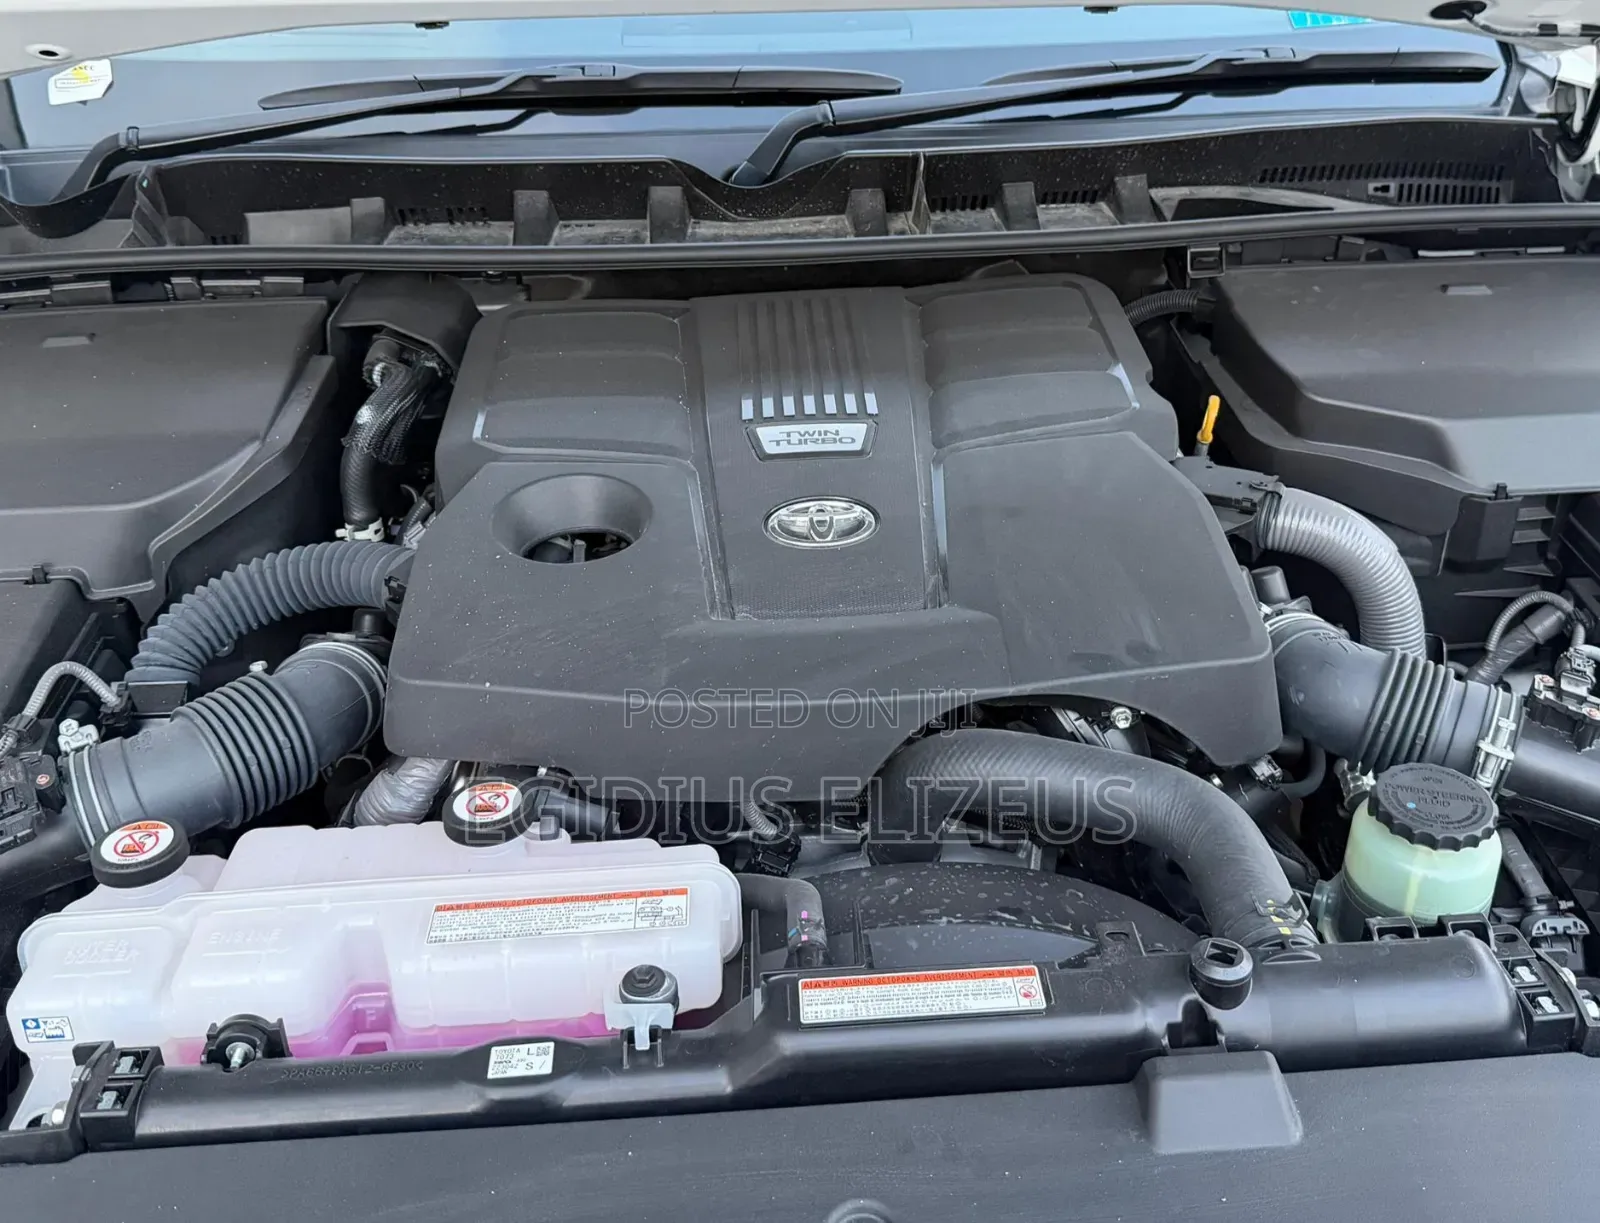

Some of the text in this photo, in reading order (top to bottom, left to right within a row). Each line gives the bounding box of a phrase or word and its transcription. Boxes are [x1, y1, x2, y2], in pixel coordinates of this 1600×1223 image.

[779, 429, 840, 438] TWIN
[768, 437, 856, 447] TURBO
[1384, 782, 1484, 804] POWER STEERING
[1418, 797, 1451, 808] FLUID
[474, 899, 507, 909] WARNING
[208, 928, 283, 945] ENGINE
[842, 977, 874, 987] WARNING
